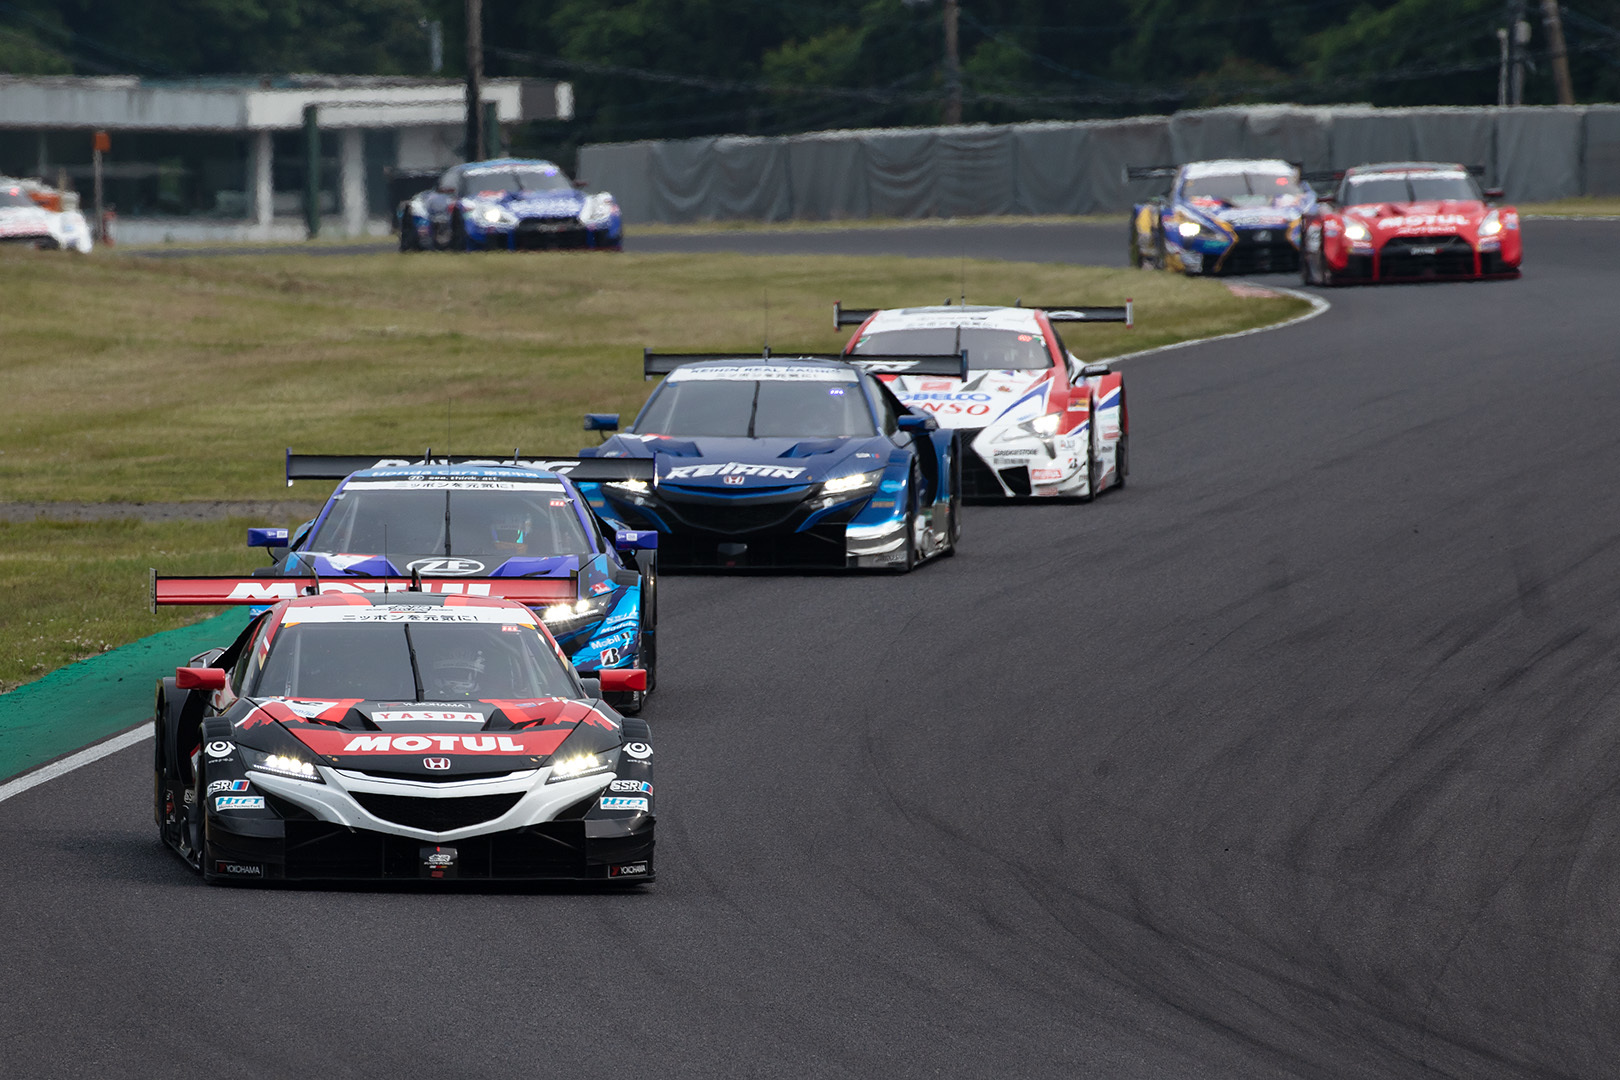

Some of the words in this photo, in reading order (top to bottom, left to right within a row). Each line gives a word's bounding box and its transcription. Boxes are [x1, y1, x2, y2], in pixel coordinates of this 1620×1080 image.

[1377, 214, 1470, 229] MOTUL
[591, 634, 620, 649] Mobil
[380, 712, 477, 721] YASDA
[344, 736, 524, 751] MOTUL
[226, 864, 260, 874] YOKOHAMA
